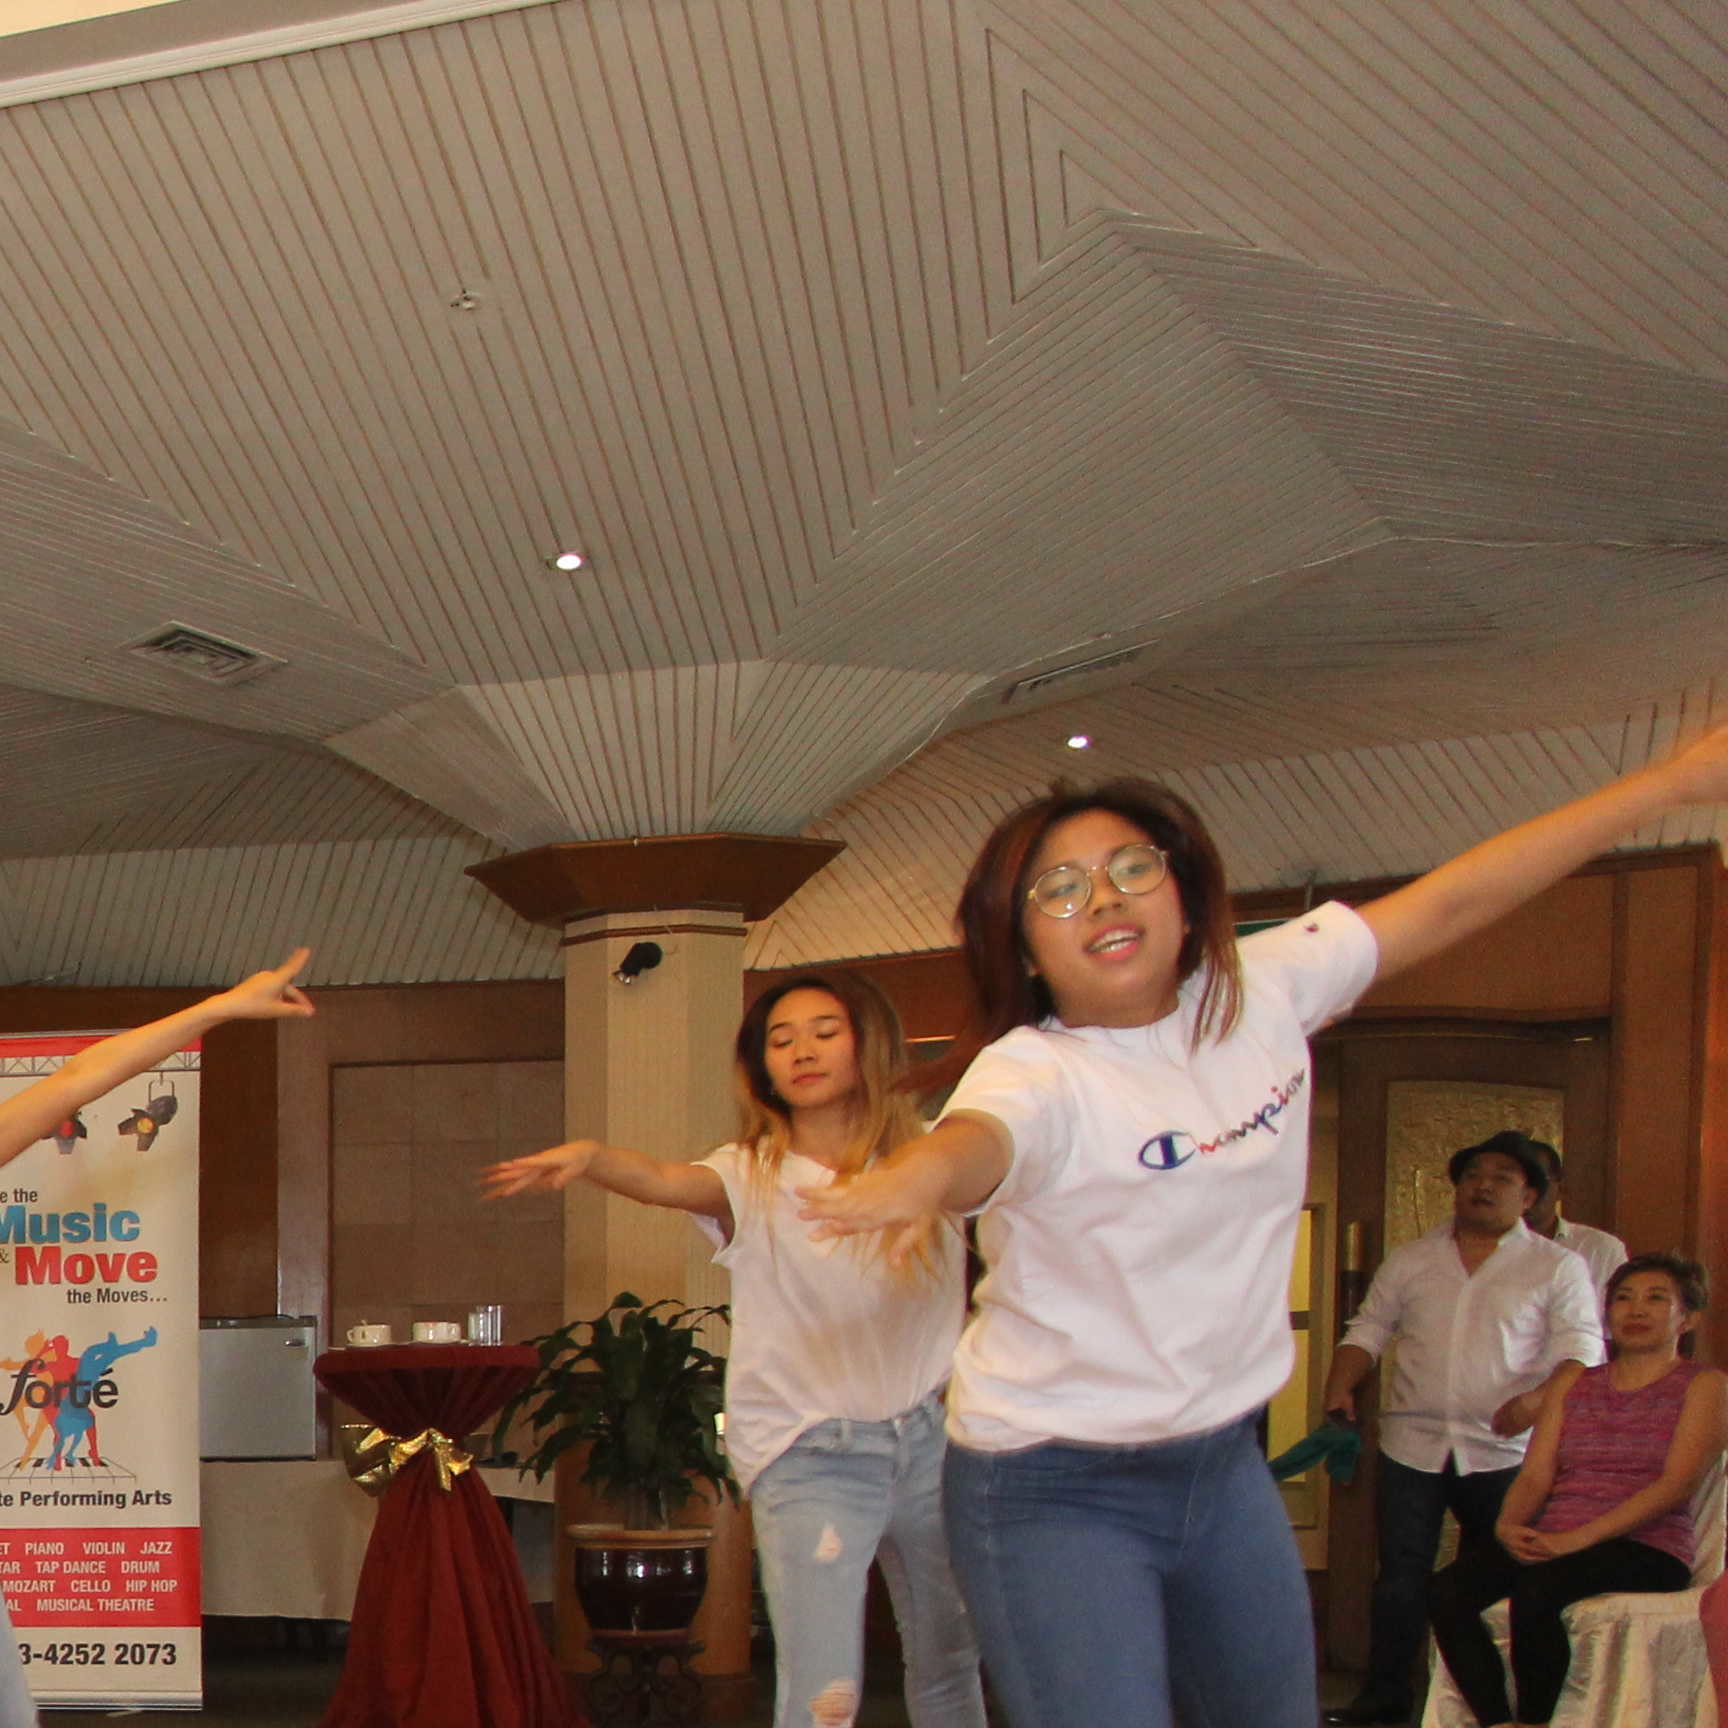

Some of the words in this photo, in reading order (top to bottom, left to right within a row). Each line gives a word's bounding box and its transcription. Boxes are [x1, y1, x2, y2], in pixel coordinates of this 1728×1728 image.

[13, 1188, 38, 1204] the
[15, 1245, 158, 1286] Move
[67, 1288, 91, 1304] the
[96, 1288, 168, 1304] Moves...
[20, 1489, 126, 1509] Performing
[132, 1489, 172, 1506] Arts
[25, 1542, 64, 1555] PIANO
[83, 1542, 125, 1555] VIOLIN
[140, 1541, 173, 1555] JAZZ
[35, 1561, 60, 1574] TAP
[63, 1561, 106, 1574] DANCE
[121, 1561, 160, 1574] DRUM
[2, 1580, 56, 1593] MOZART
[71, 1579, 111, 1593] CELLO
[126, 1579, 147, 1593] HIP
[151, 1579, 178, 1593] HOP
[37, 1598, 94, 1612] MUSICAL
[97, 1598, 155, 1612] THEATRE
[18, 1643, 105, 1666] 3-4252
[114, 1643, 177, 1665] 2073
